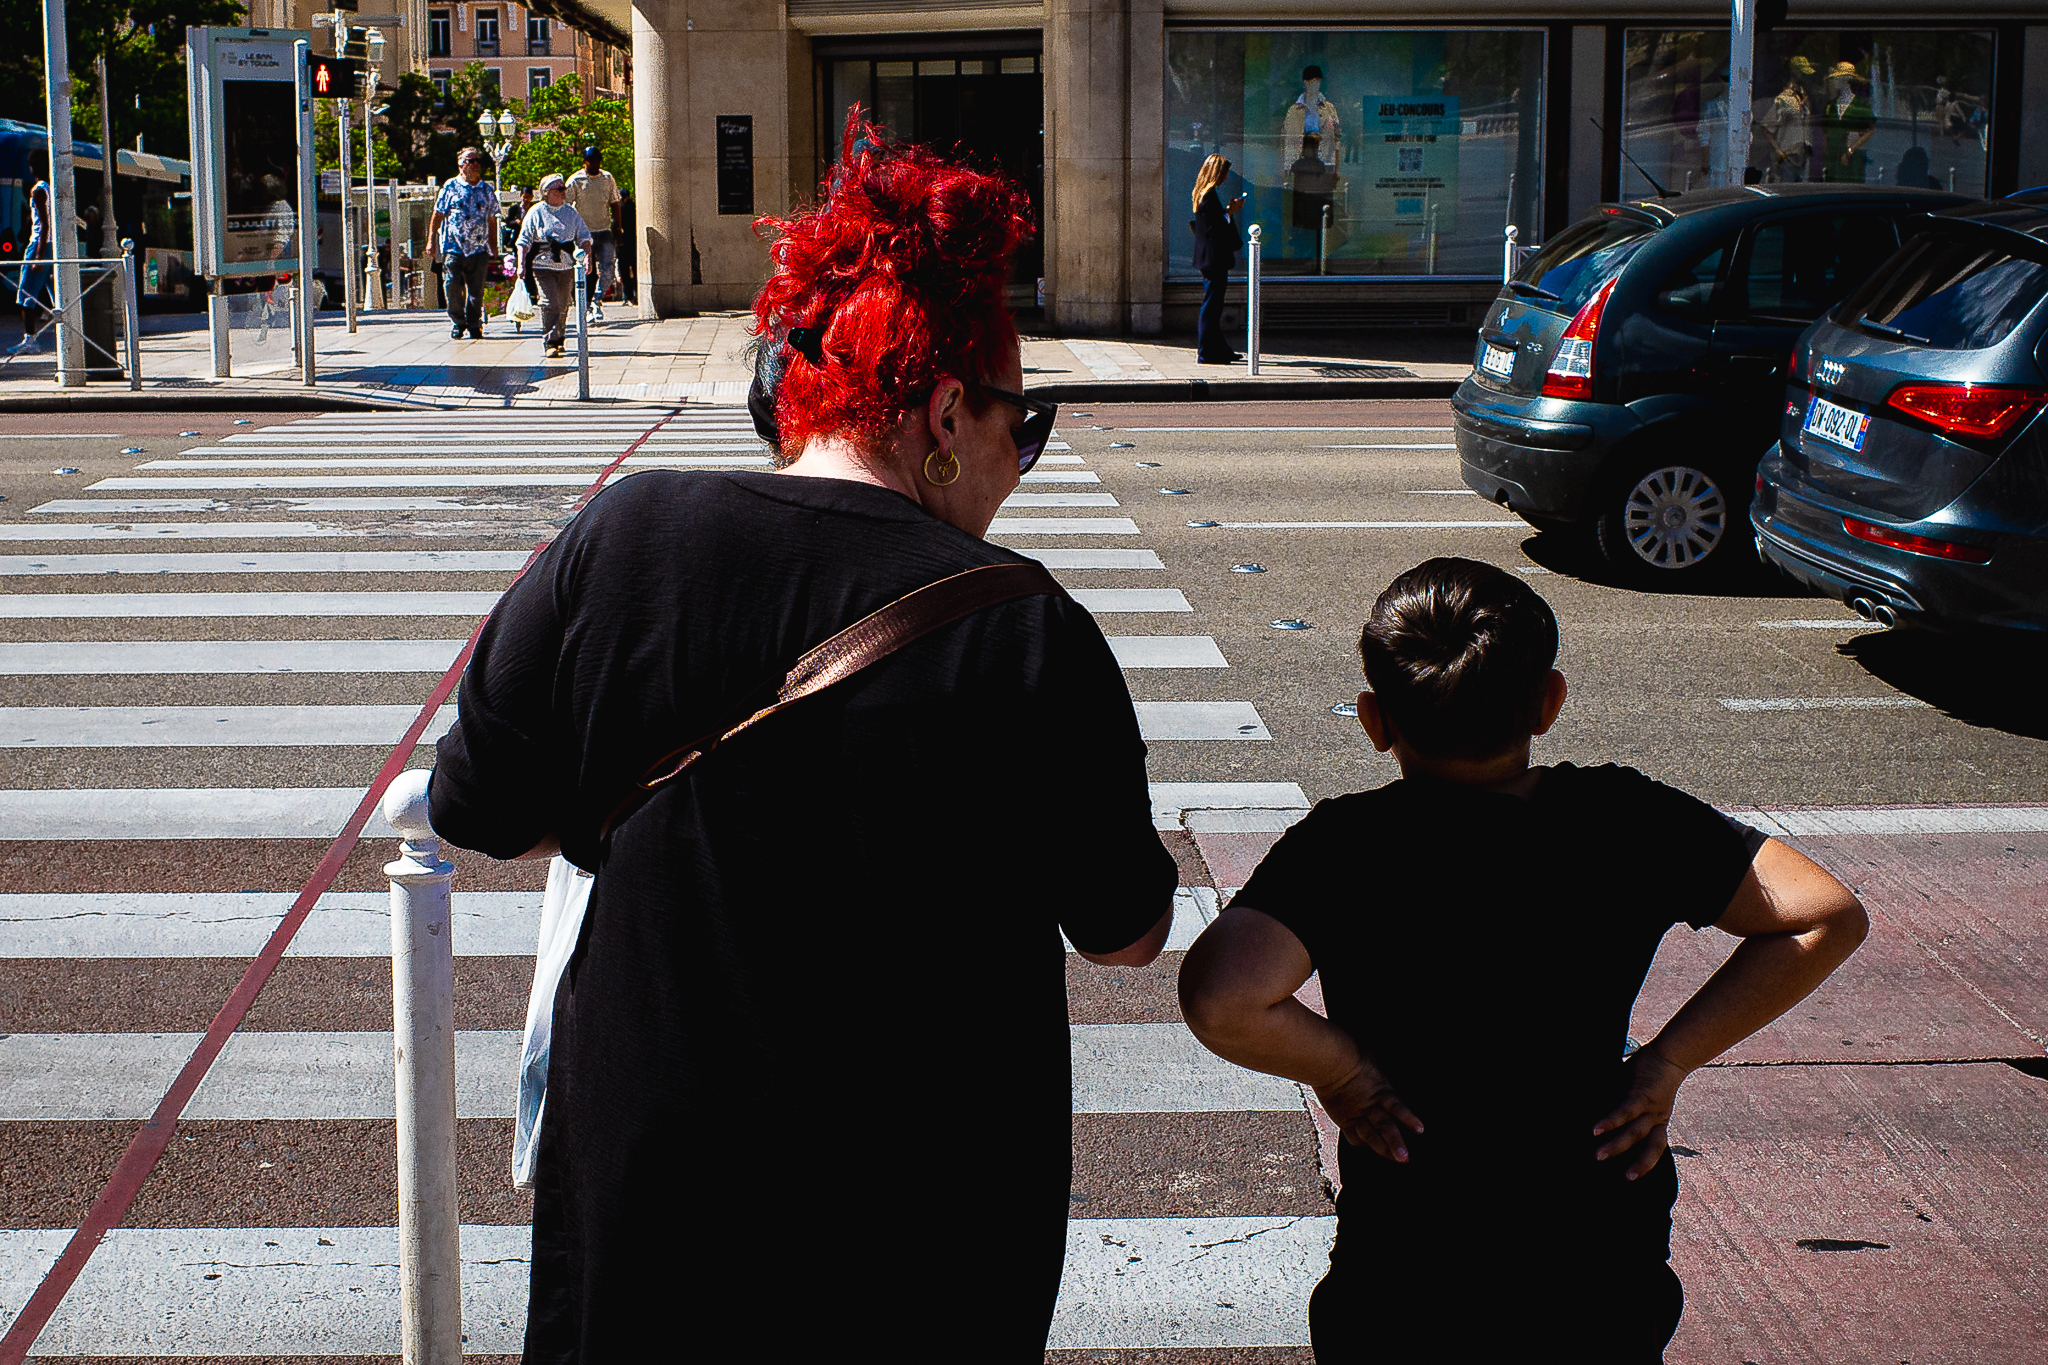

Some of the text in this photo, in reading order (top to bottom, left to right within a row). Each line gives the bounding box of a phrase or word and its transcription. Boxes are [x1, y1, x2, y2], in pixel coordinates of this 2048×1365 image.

[250, 60, 280, 68] TOULON
[1378, 103, 1445, 116] JEU-CONCOURS
[242, 219, 276, 228] JUILLET
